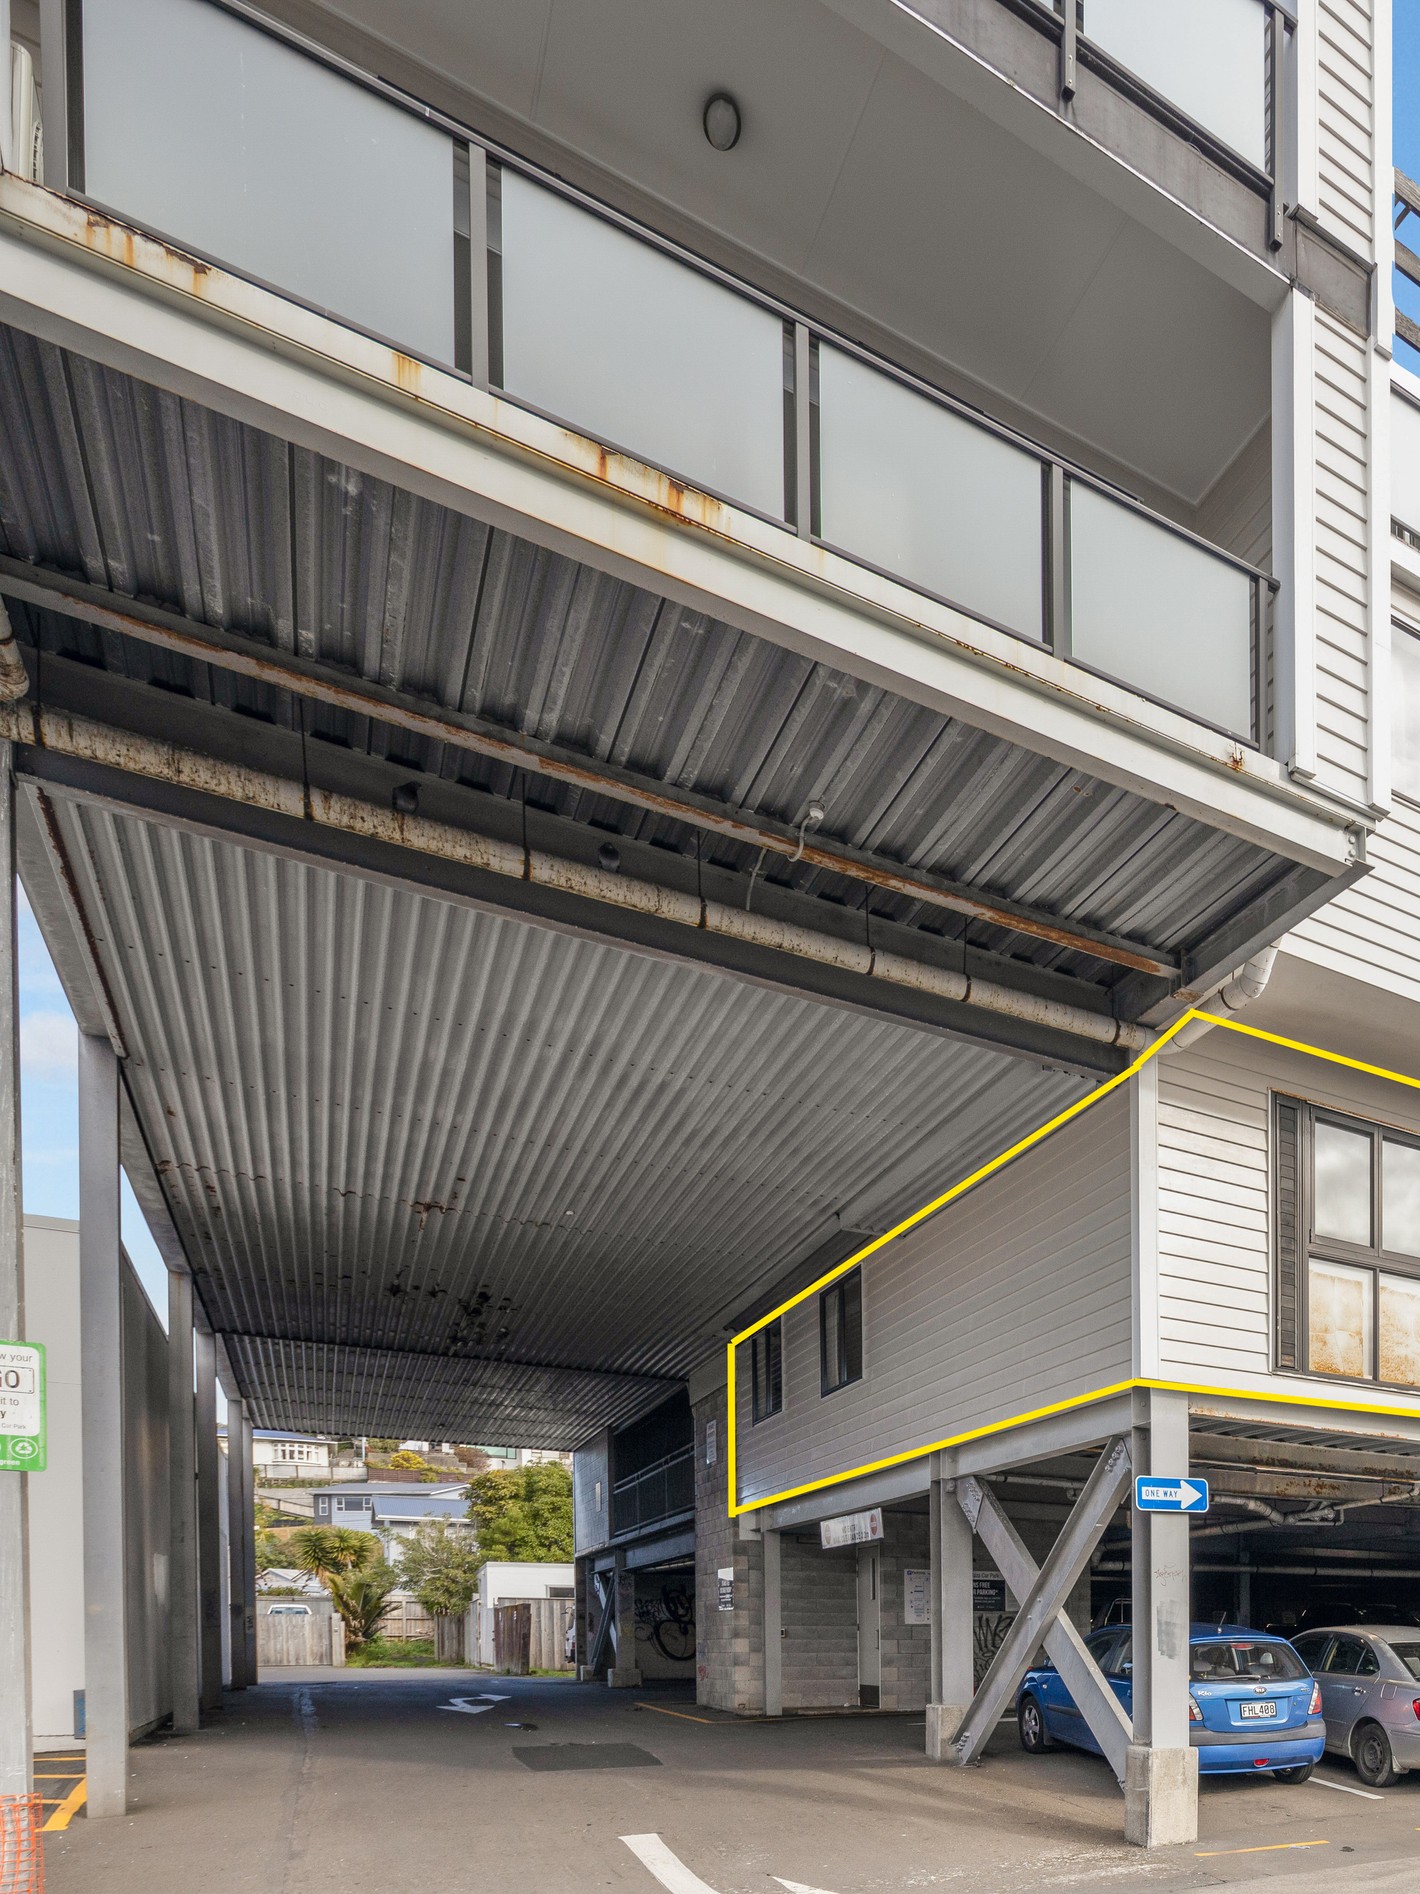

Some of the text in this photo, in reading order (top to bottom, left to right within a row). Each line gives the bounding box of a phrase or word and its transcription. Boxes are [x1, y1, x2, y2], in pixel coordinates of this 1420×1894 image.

[10, 1354, 32, 1362] your
[10, 1398, 19, 1406] to
[1145, 1489, 1178, 1498] ONE WAY
[1242, 1704, 1275, 1717] FHL408
